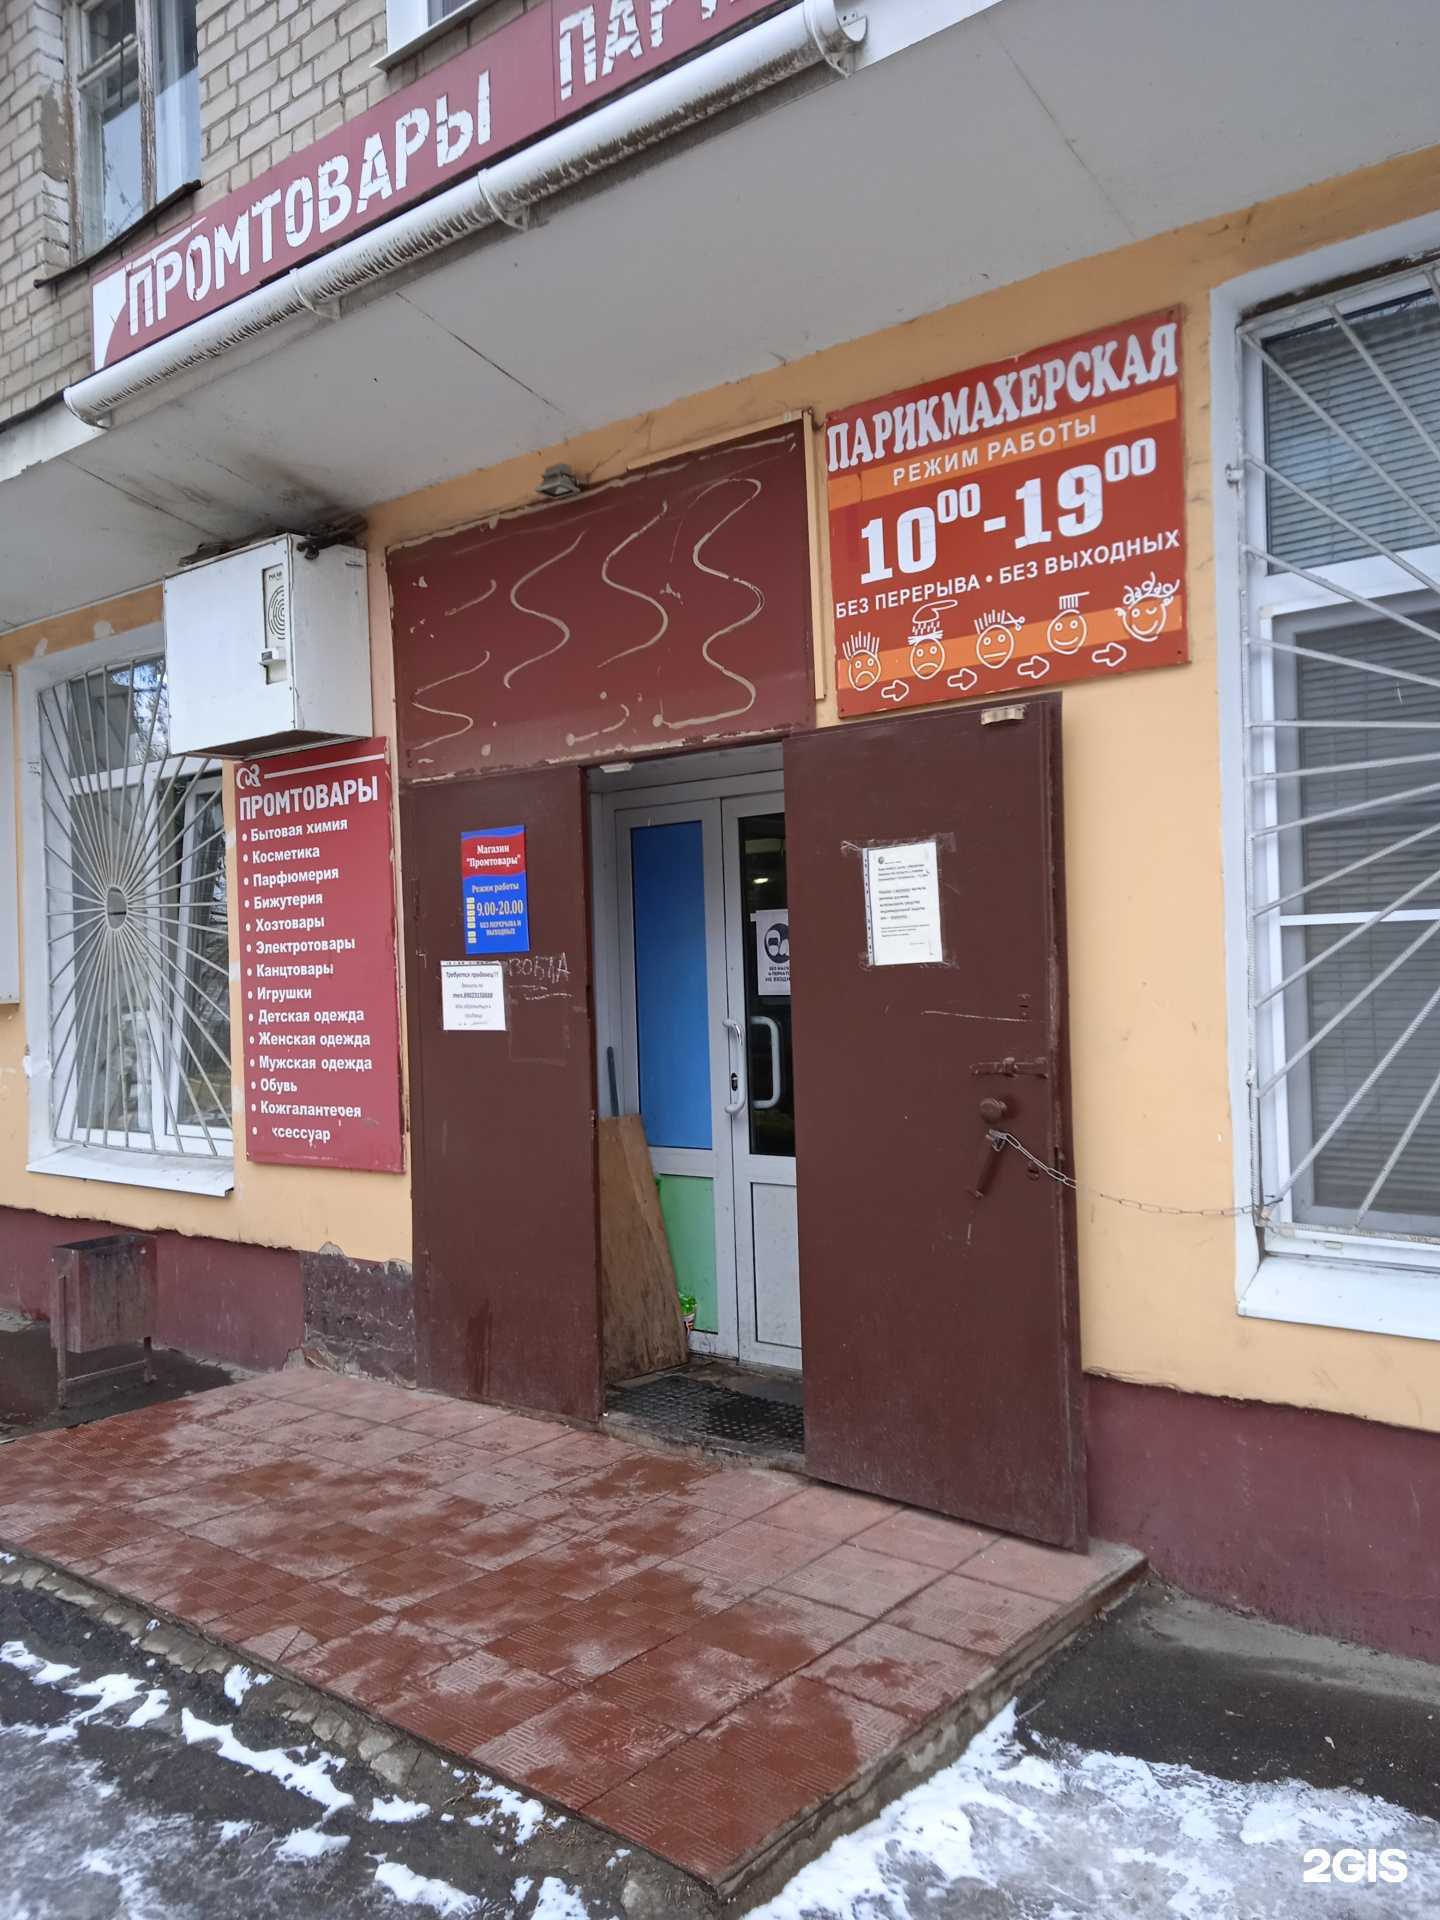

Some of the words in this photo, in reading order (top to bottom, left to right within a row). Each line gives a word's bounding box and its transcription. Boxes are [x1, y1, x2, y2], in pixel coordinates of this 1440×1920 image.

[125, 69, 492, 336] ПРОМТОВАРЫ
[827, 322, 1178, 472] ПАРИКМАХЕРСКАЯ
[893, 450, 979, 486] РЕЖИМ
[987, 414, 1097, 461] РАБОТЫ
[836, 598, 869, 618] БЕЗ
[874, 574, 980, 610] ПЕРЕРЫВА
[999, 560, 1038, 585] БЕЗ
[1044, 529, 1180, 572] ВЫХОДНЫХ
[239, 776, 378, 821] ПРОМТОВАРЫ
[251, 824, 302, 842] Бытовая
[306, 818, 348, 835] химия
[252, 846, 320, 864] Косметика
[476, 844, 510, 855] Магазин
[253, 867, 339, 888] Парфюмерия
[254, 892, 323, 910] Бижутерия
[476, 899, 523, 917] 9.00-20.00
[255, 915, 325, 933] Хозтовары
[255, 937, 355, 956] Электротовары
[256, 963, 334, 979] Канцтовары
[257, 986, 312, 1002] Игрушки
[258, 1009, 310, 1024] Детская
[313, 1009, 365, 1024] одежда
[258, 1031, 316, 1046] Женская
[320, 1032, 371, 1047] одежда
[259, 1055, 316, 1072] Мужская
[321, 1056, 373, 1071] одежда
[260, 1078, 298, 1095] Обувь
